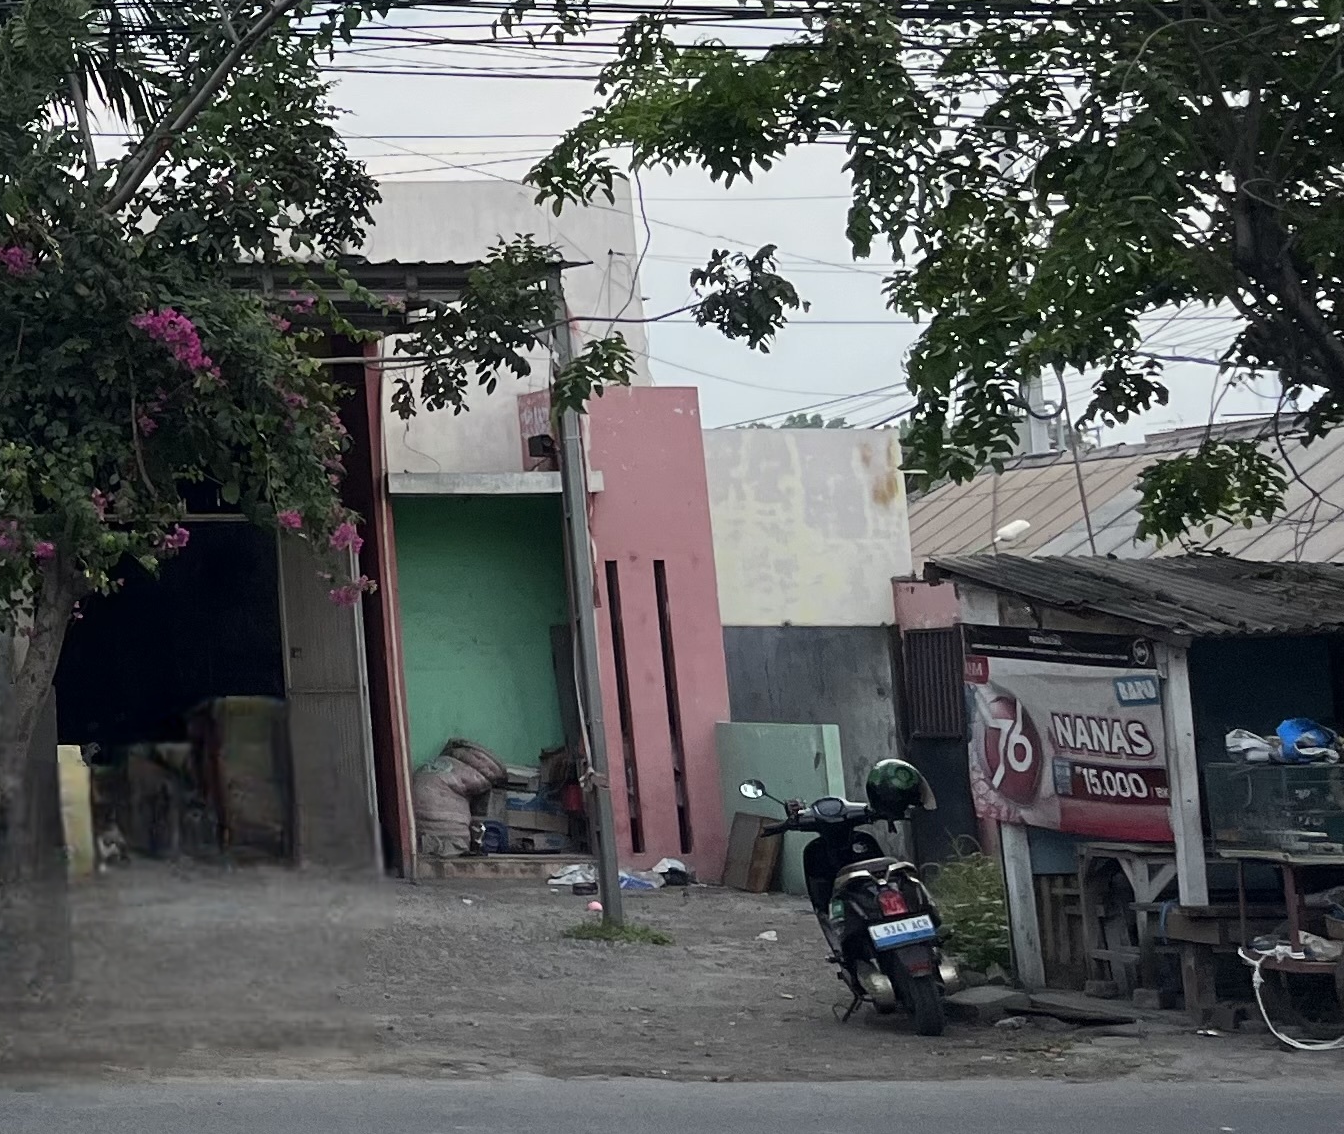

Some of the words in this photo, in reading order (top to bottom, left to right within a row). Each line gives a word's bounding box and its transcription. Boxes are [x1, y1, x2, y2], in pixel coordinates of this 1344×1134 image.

[979, 691, 1033, 789] 76
[1051, 714, 1155, 758] NANAS
[1082, 768, 1148, 798] 15.000
